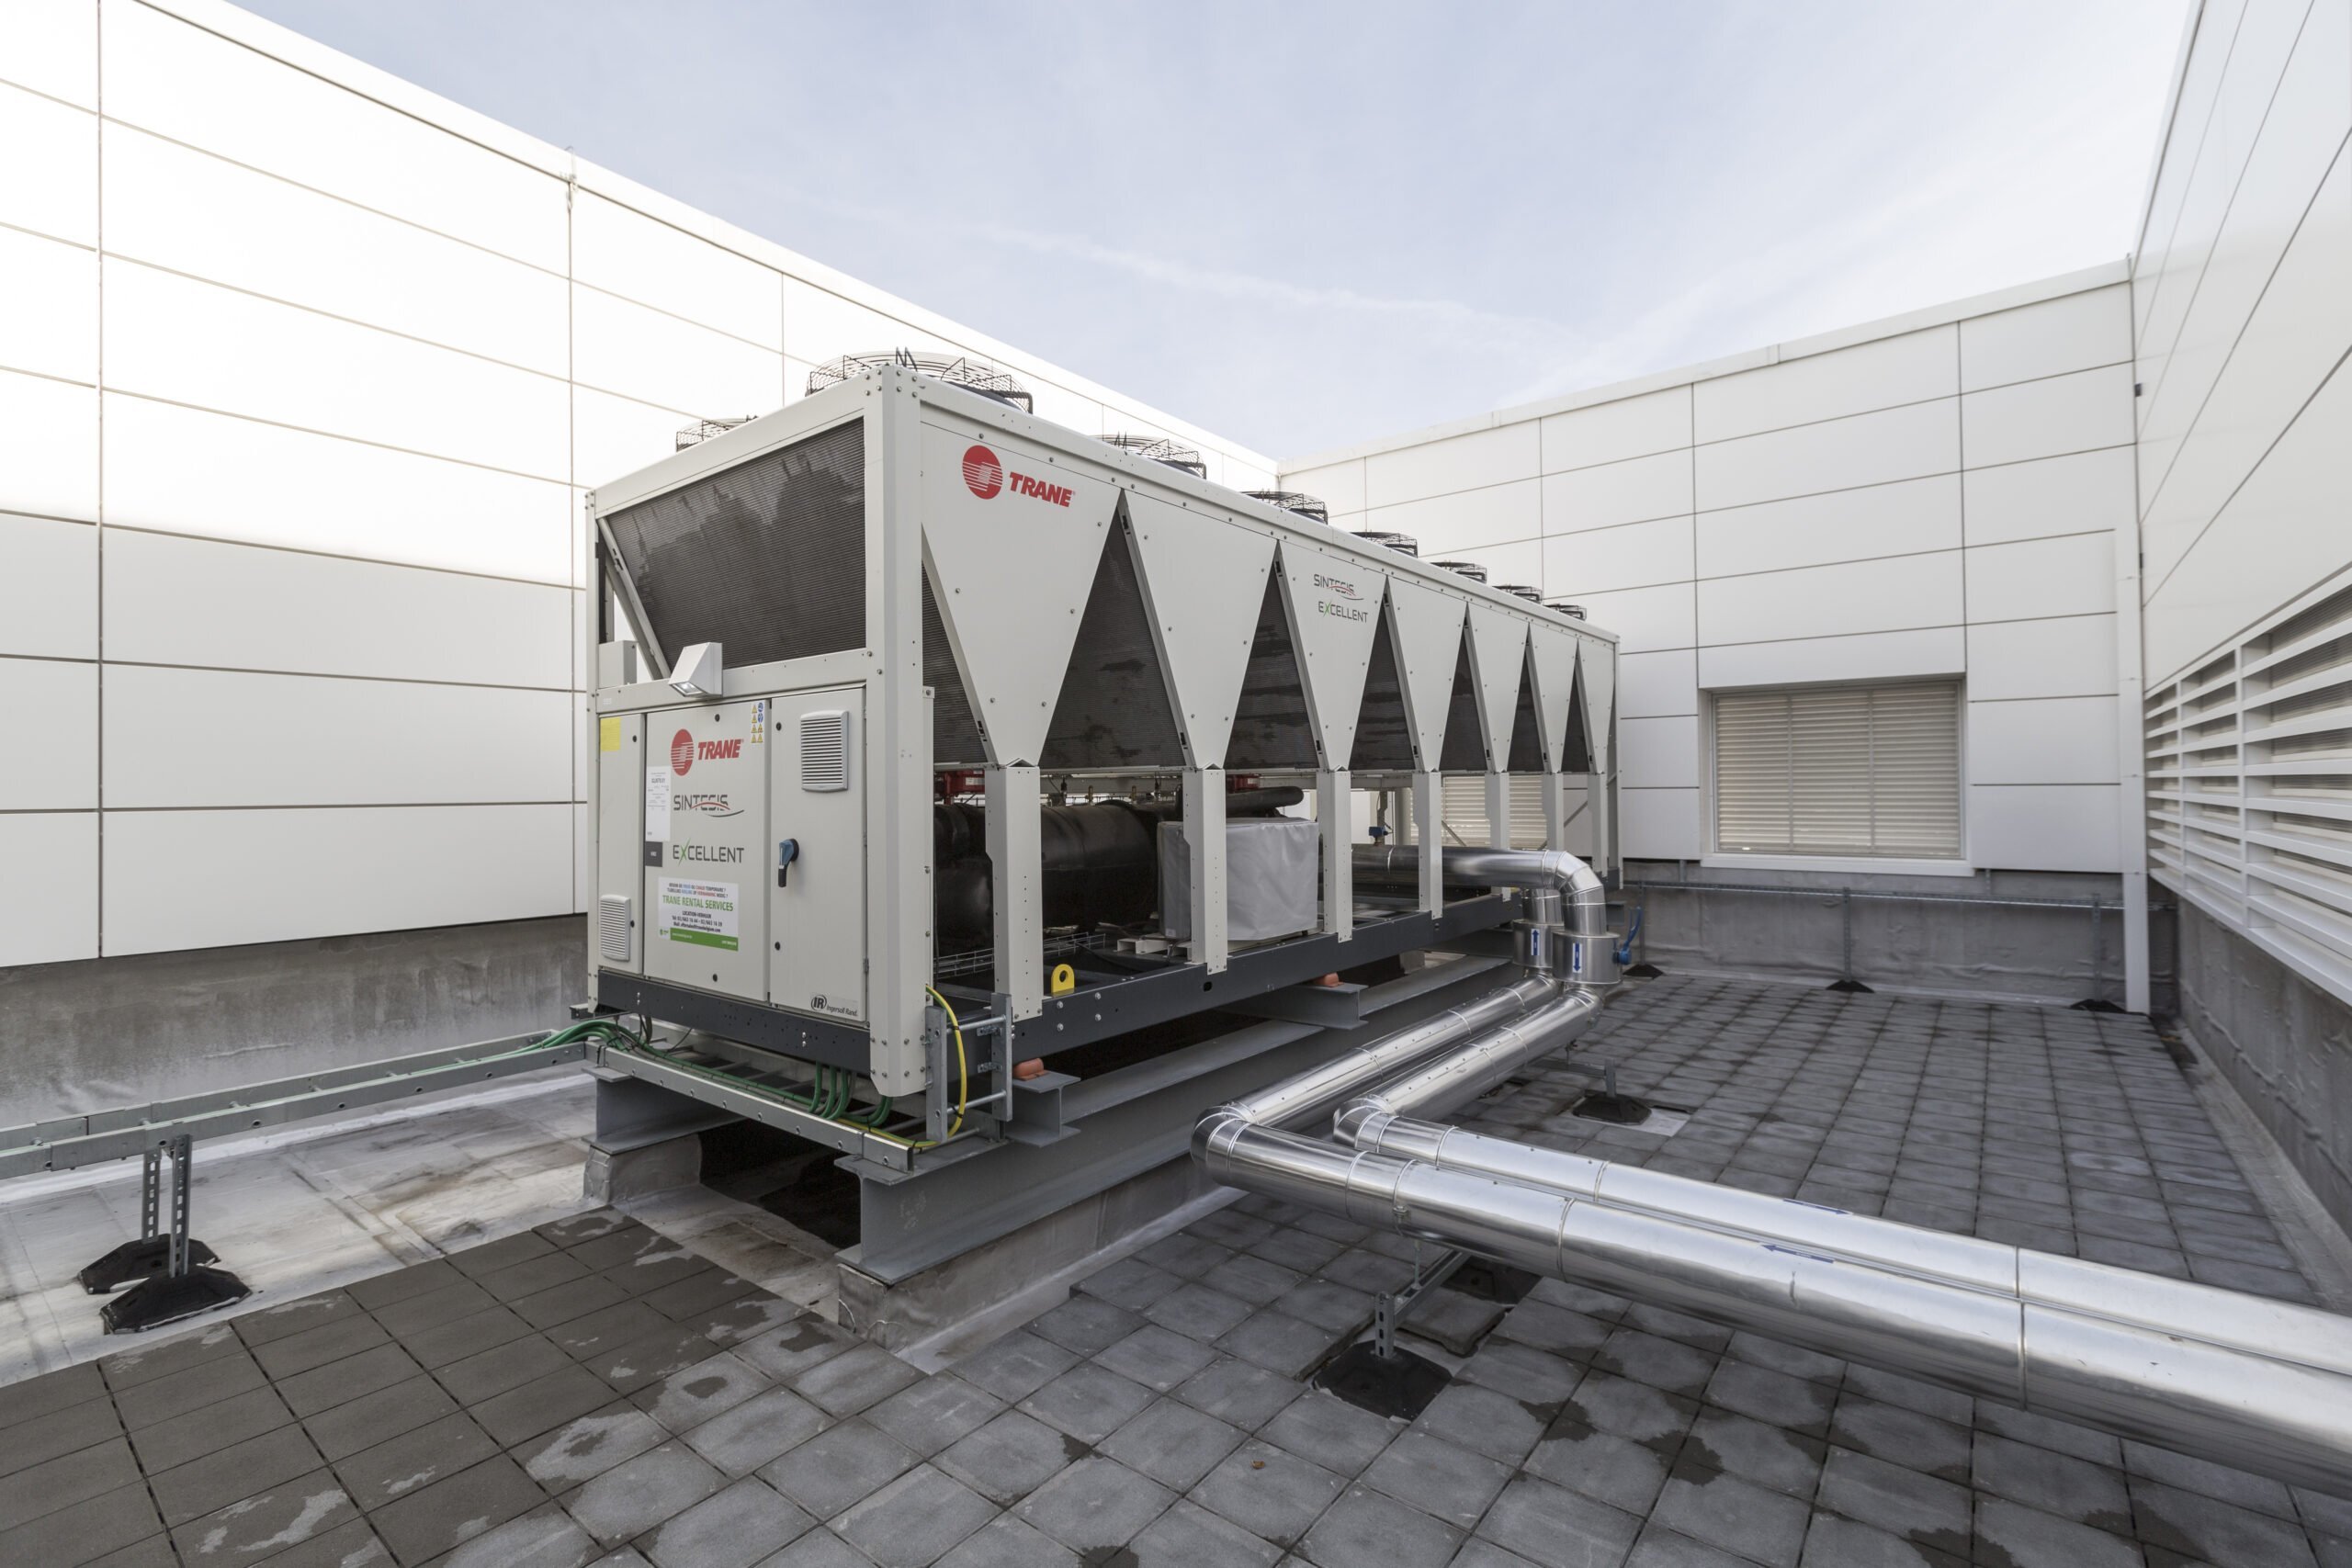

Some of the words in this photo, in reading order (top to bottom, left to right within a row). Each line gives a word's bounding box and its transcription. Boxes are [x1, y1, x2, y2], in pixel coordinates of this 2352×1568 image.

[1010, 471, 1073, 507] TRANE
[1318, 601, 1368, 624] EXCELLENT
[698, 739, 741, 761] TRANE
[673, 839, 744, 866] EXCELLENT
[662, 895, 681, 906] TRANE
[682, 897, 704, 908] RENTAL
[705, 899, 734, 911] SERVICES
[827, 1004, 845, 1014] Ingersoll
